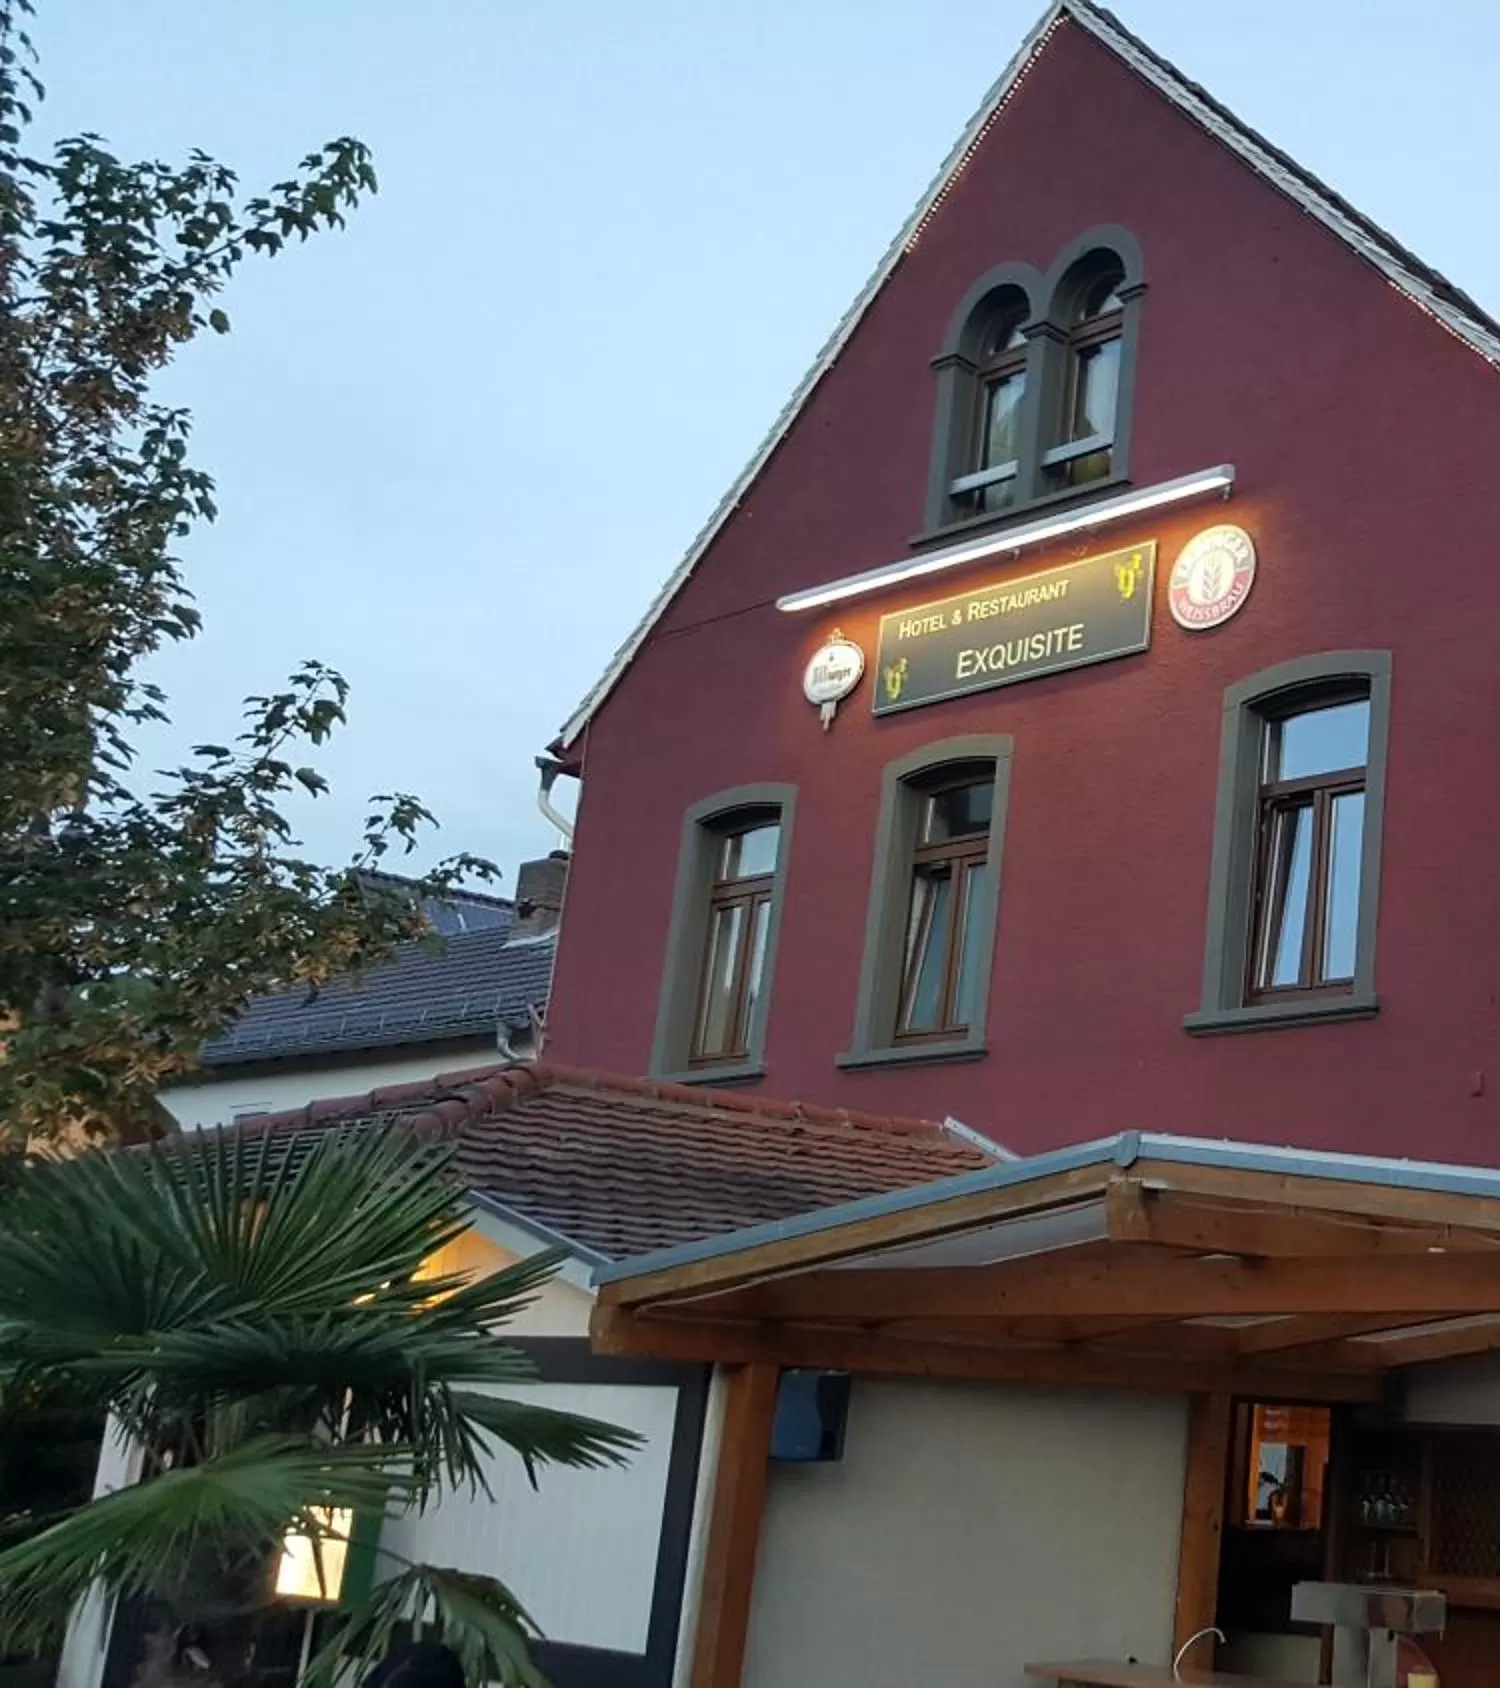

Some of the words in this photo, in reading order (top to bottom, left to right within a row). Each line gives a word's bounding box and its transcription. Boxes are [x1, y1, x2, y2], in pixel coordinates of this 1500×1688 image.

[898, 614, 948, 640] HOTEL
[951, 609, 963, 626] &
[967, 579, 1071, 622] RESTAURANT
[955, 623, 1085, 679] EXQUISITE
